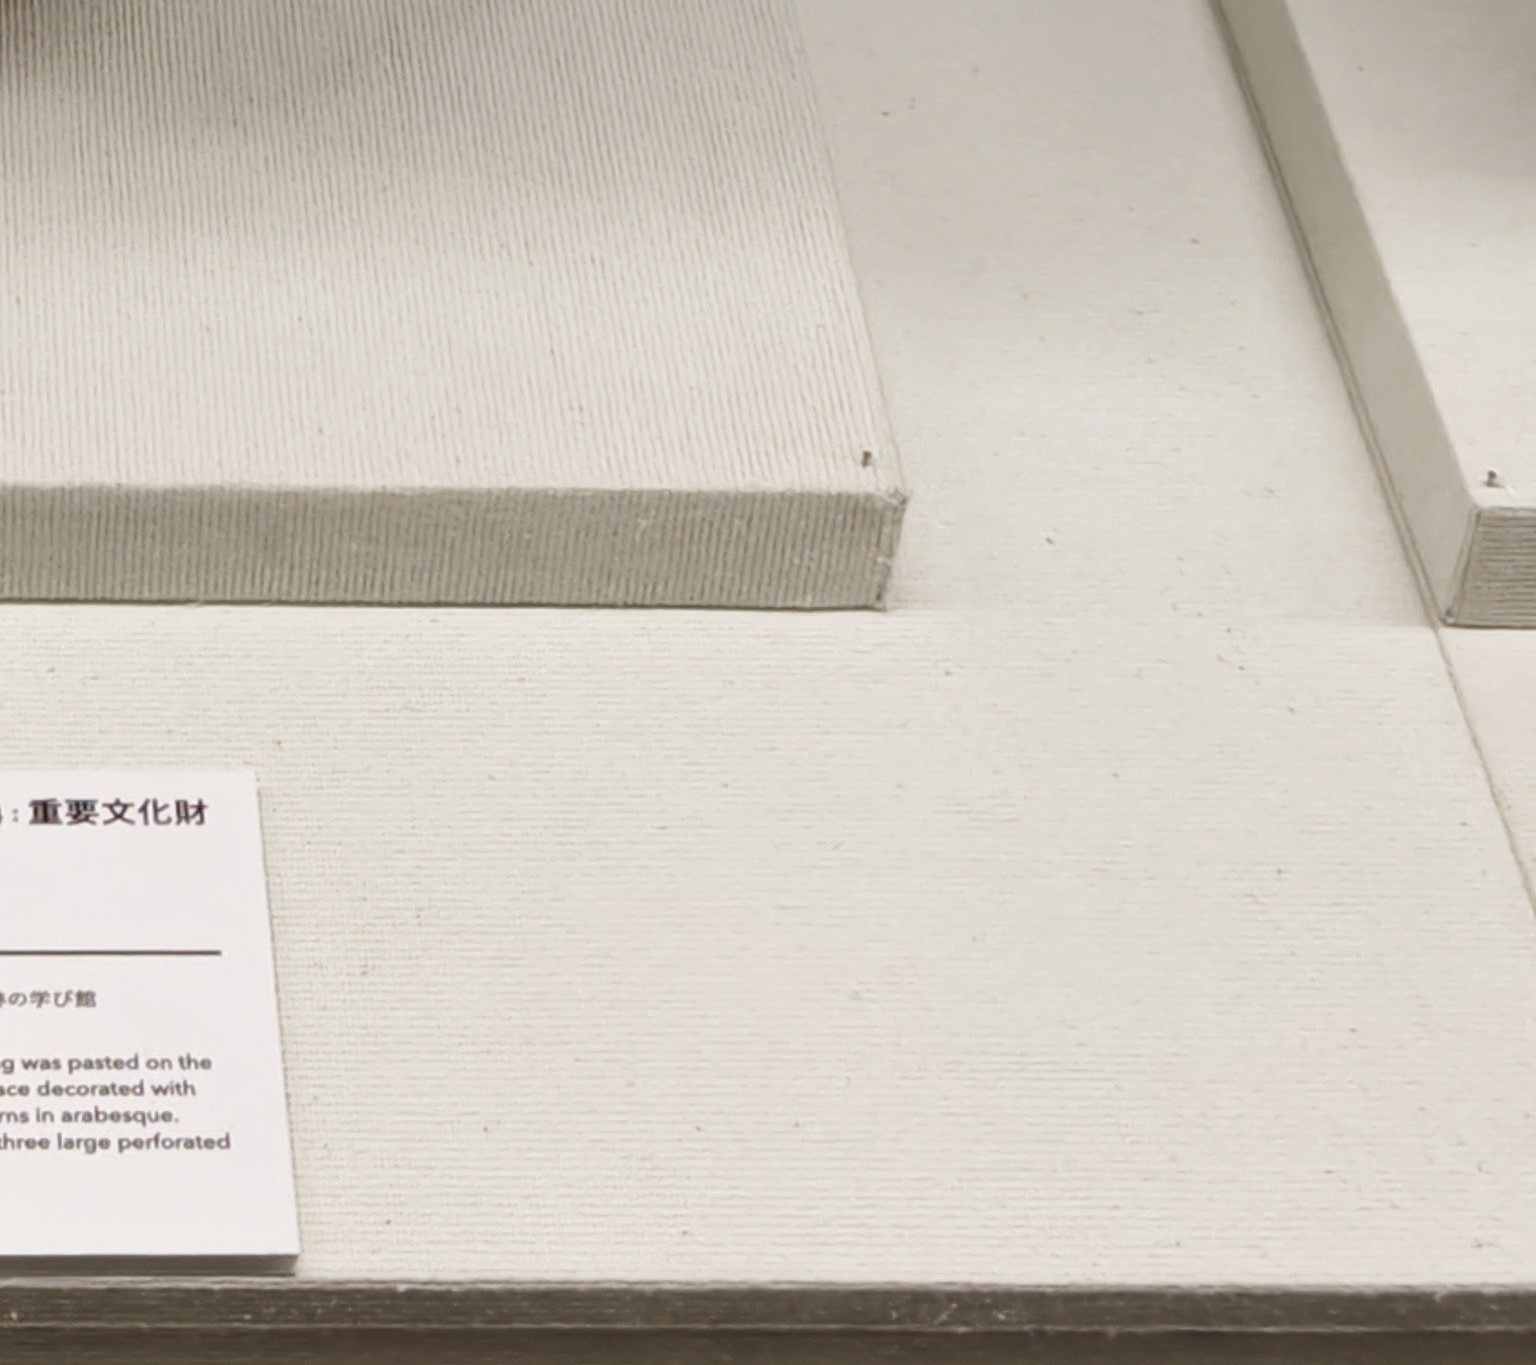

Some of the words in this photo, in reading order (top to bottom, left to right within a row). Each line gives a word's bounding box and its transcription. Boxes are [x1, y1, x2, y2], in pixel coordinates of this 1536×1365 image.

[20, 1057, 63, 1072] was
[66, 1052, 140, 1076] pasted
[144, 1057, 174, 1072] on
[177, 1052, 213, 1072] the
[36, 1078, 146, 1098] decorated
[150, 1078, 197, 1097] with
[35, 1106, 55, 1124] in
[60, 1104, 179, 1128] arabesque.
[56, 1131, 112, 1156] large
[117, 1131, 232, 1155] perforated
